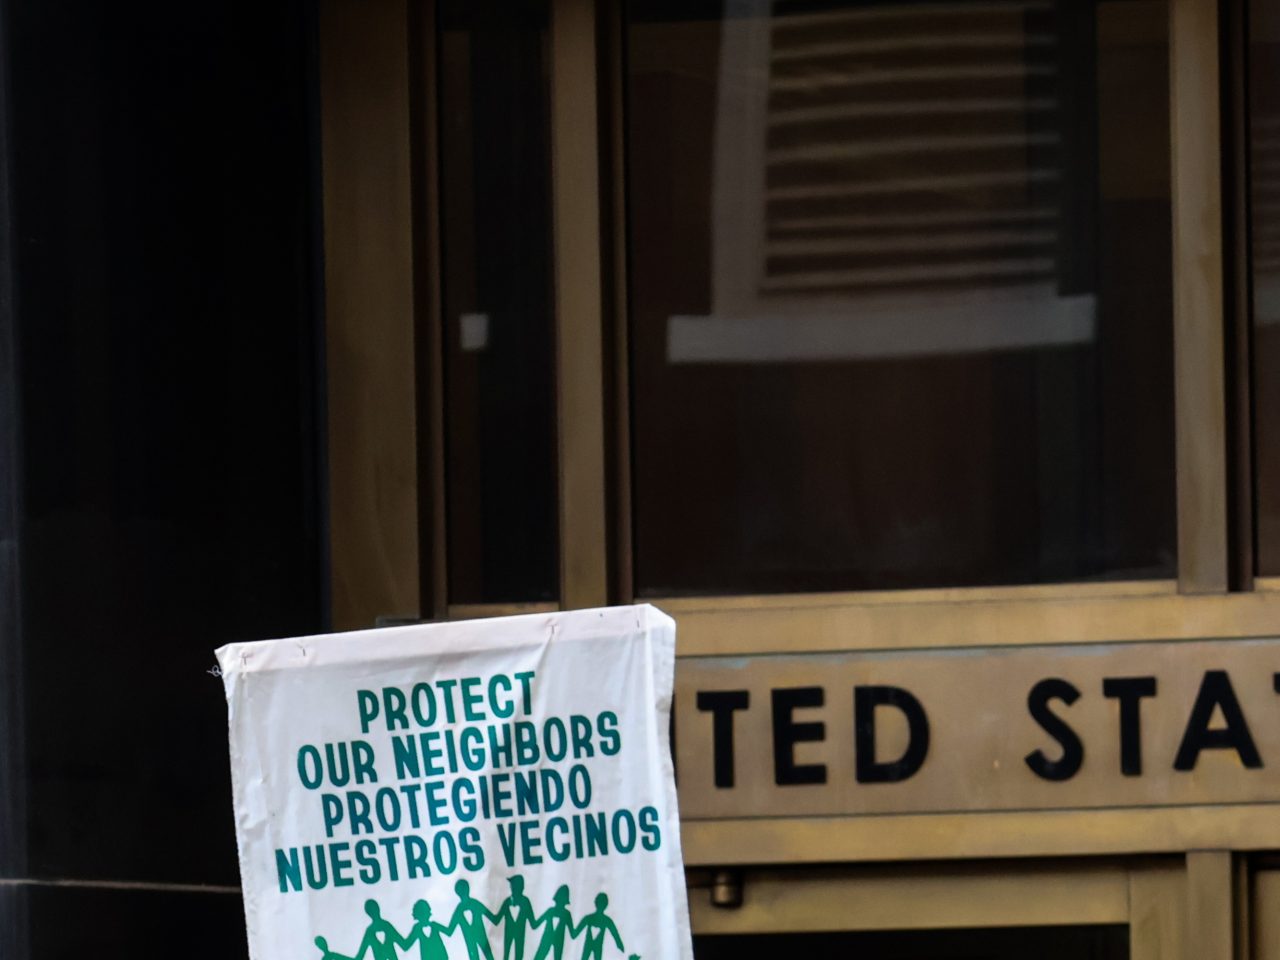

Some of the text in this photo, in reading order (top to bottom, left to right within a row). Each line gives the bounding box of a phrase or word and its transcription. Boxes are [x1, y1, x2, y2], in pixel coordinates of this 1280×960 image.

[356, 671, 536, 733] PROTECT
[669, 685, 930, 789] TED
[297, 710, 622, 790] OUR NEIGHBORS
[322, 764, 592, 838] PROTEGIENDO
[275, 806, 661, 893] NUESTROS VECINOS
